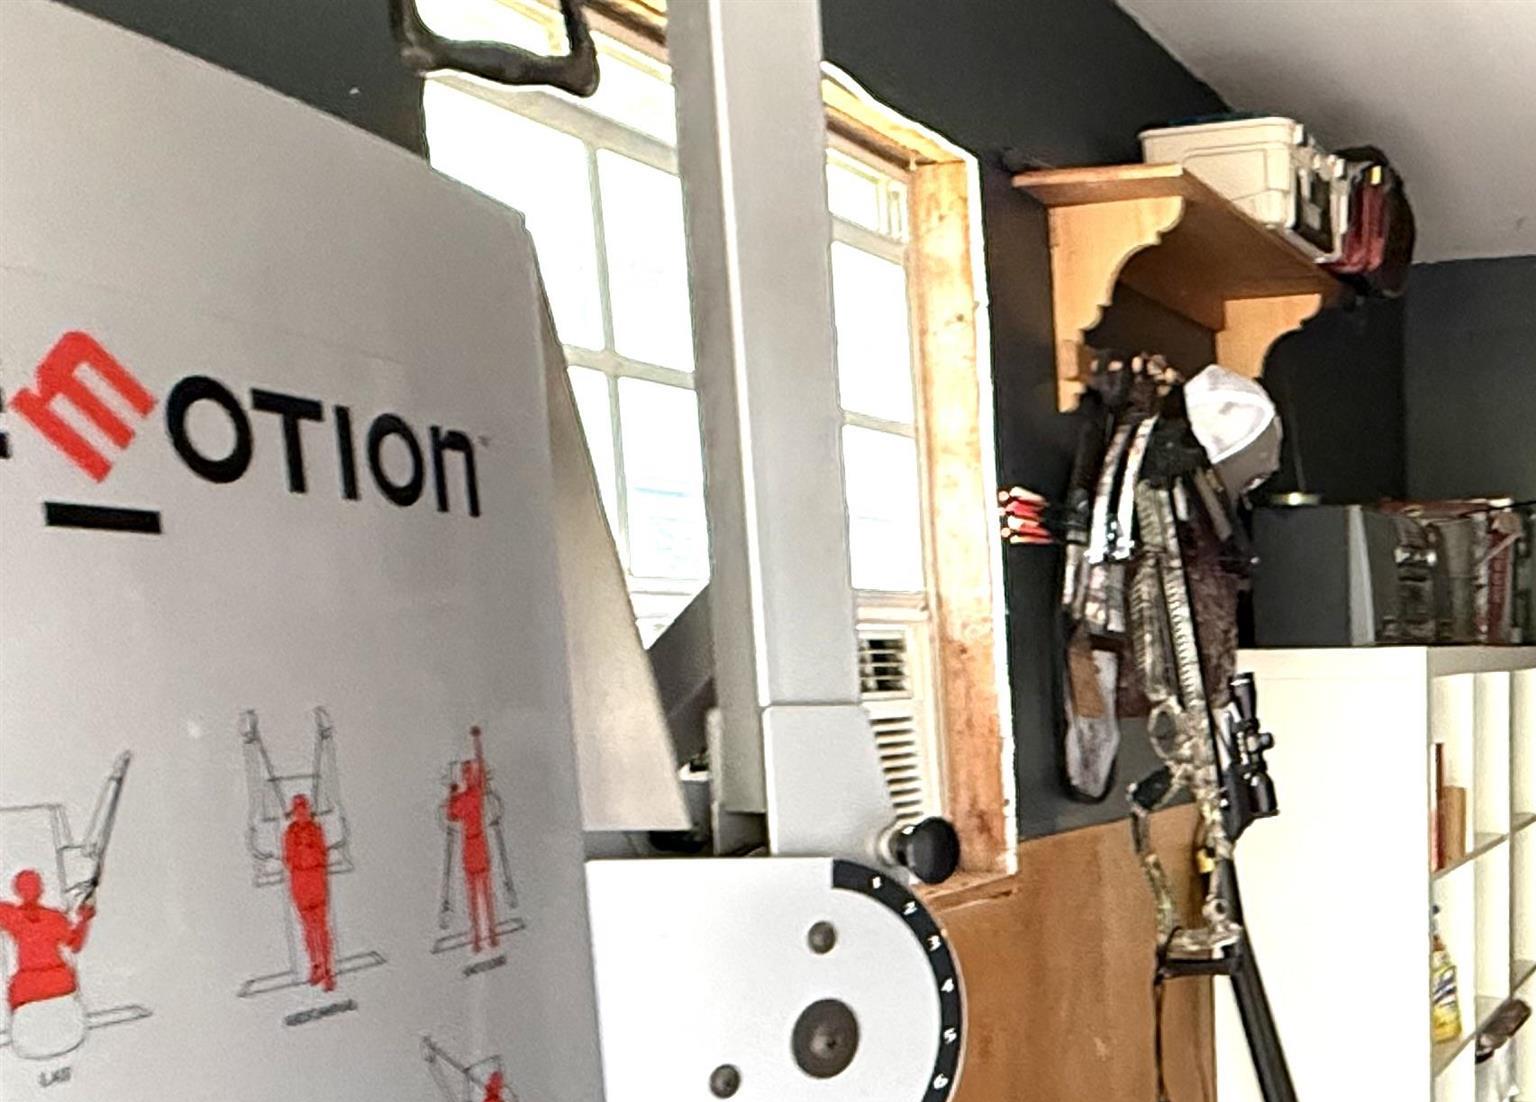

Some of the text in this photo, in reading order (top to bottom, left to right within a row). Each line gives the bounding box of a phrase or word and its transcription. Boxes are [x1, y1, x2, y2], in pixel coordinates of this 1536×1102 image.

[903, 901, 917, 915] 2
[928, 935, 941, 951] 3
[941, 978, 954, 993] 4
[943, 1027, 957, 1044] 5
[933, 1073, 949, 1090] 6
